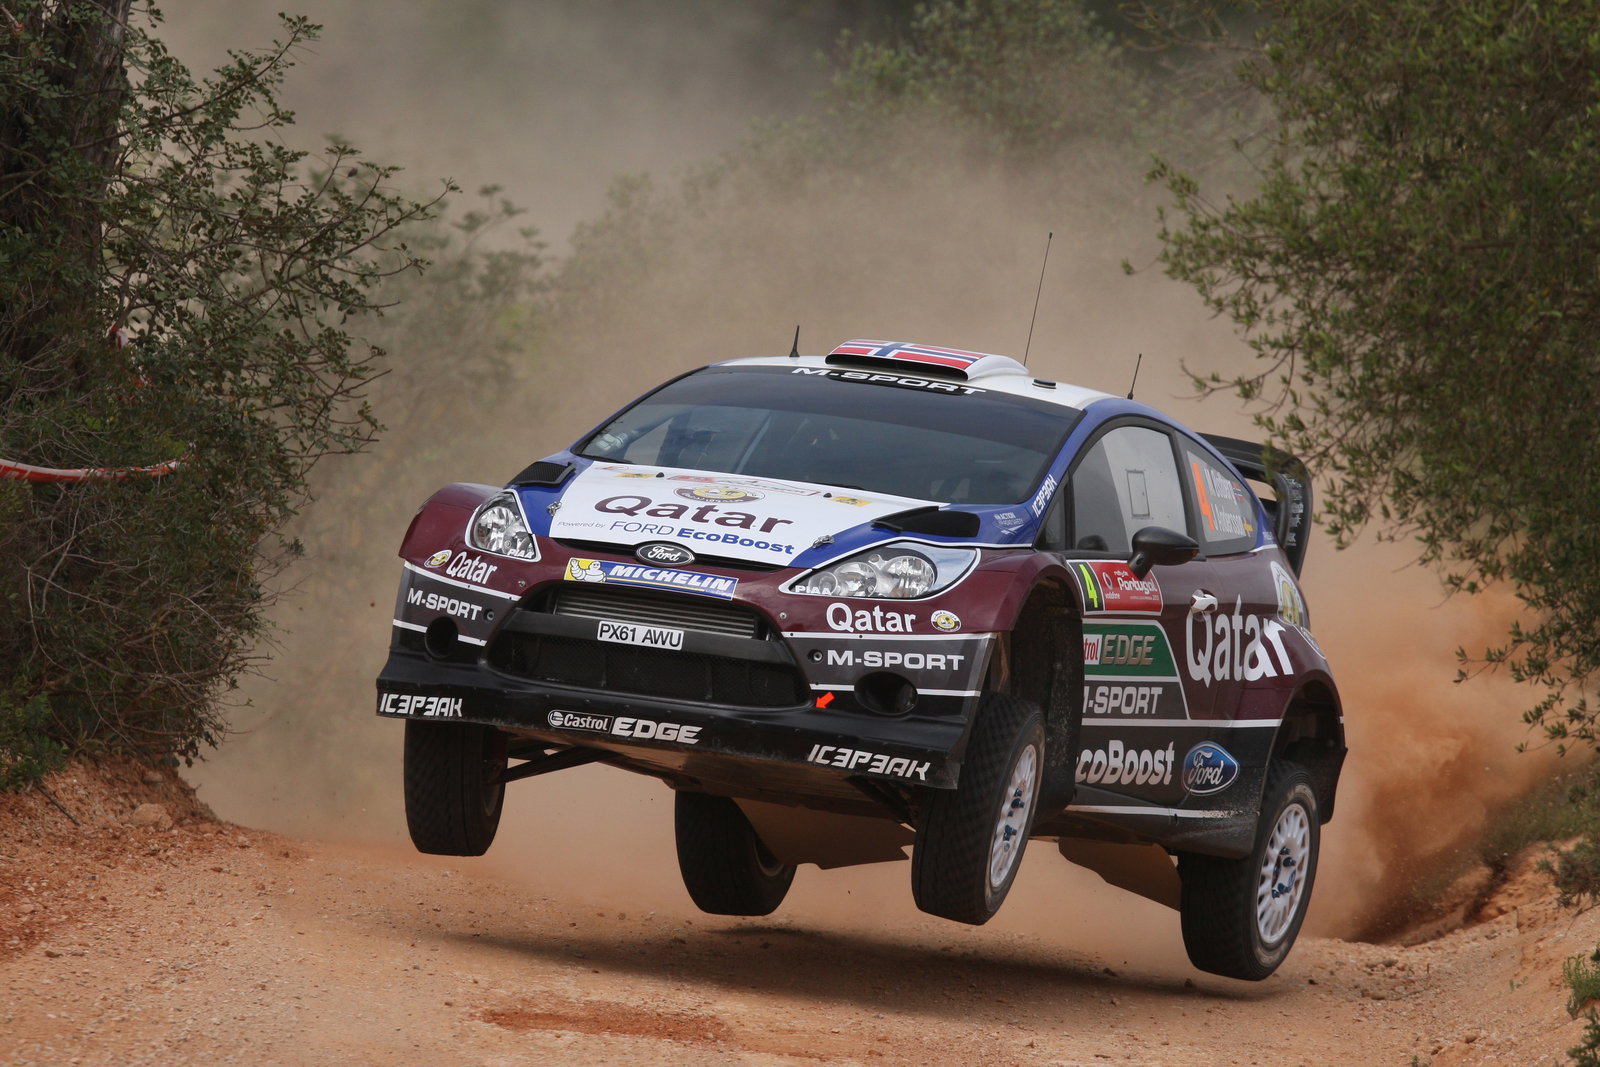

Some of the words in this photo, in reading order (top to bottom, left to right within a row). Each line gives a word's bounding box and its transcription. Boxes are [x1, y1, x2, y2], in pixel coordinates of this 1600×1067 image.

[791, 367, 987, 395] M-SPORT
[1192, 462, 1216, 531] 4
[594, 495, 794, 533] Qatar
[609, 520, 674, 536] FORD
[676, 527, 795, 555] EcoBoost
[446, 551, 497, 585] Qatar
[507, 548, 534, 559] PIAA
[647, 545, 681, 562] Ford
[609, 564, 733, 591] MICHELIN
[795, 585, 832, 596] PIAA
[1079, 564, 1098, 608] 4
[1117, 577, 1158, 595] Portugal
[407, 588, 483, 620] M-SPORT
[826, 602, 916, 633] Qatar
[599, 623, 637, 642] PX61
[641, 628, 682, 648] AWU
[1101, 634, 1157, 665] EDGE
[1186, 594, 1294, 688] Qatar
[827, 649, 965, 671] M-SPORT
[564, 713, 608, 731] Castrol
[611, 716, 703, 745] EDGE
[1075, 739, 1175, 785] coBoost
[1188, 750, 1224, 785] Ford
